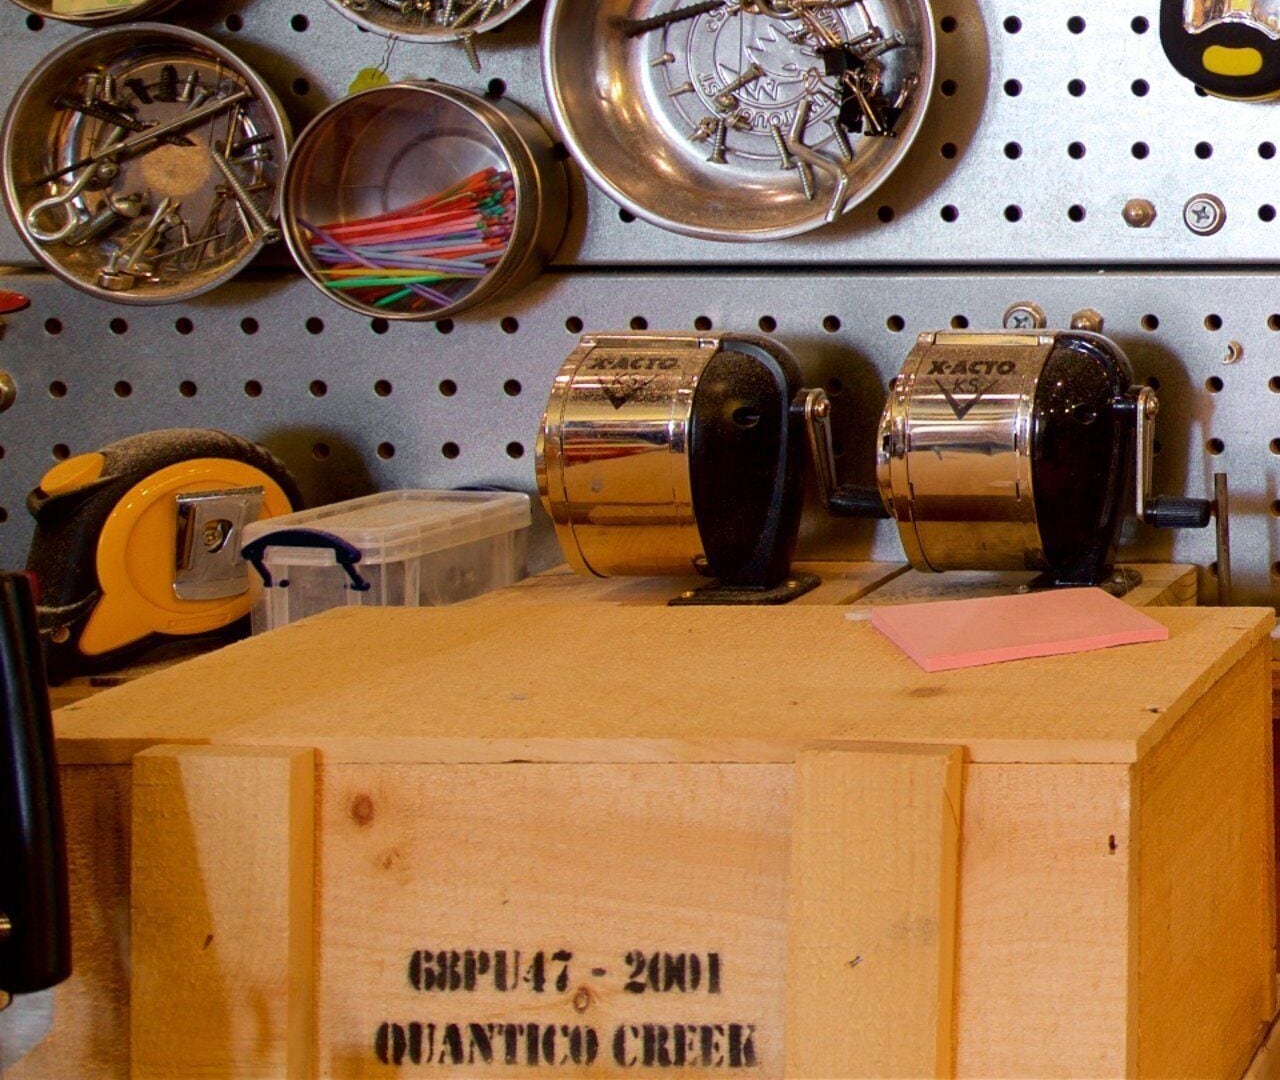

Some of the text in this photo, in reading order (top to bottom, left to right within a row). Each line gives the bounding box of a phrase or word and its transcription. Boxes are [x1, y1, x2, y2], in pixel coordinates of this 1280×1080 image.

[926, 359, 1016, 376] X-ACTO
[952, 377, 981, 395] KS
[624, 949, 722, 994] 2001
[374, 1021, 758, 1068] QUANTICO CREEK
